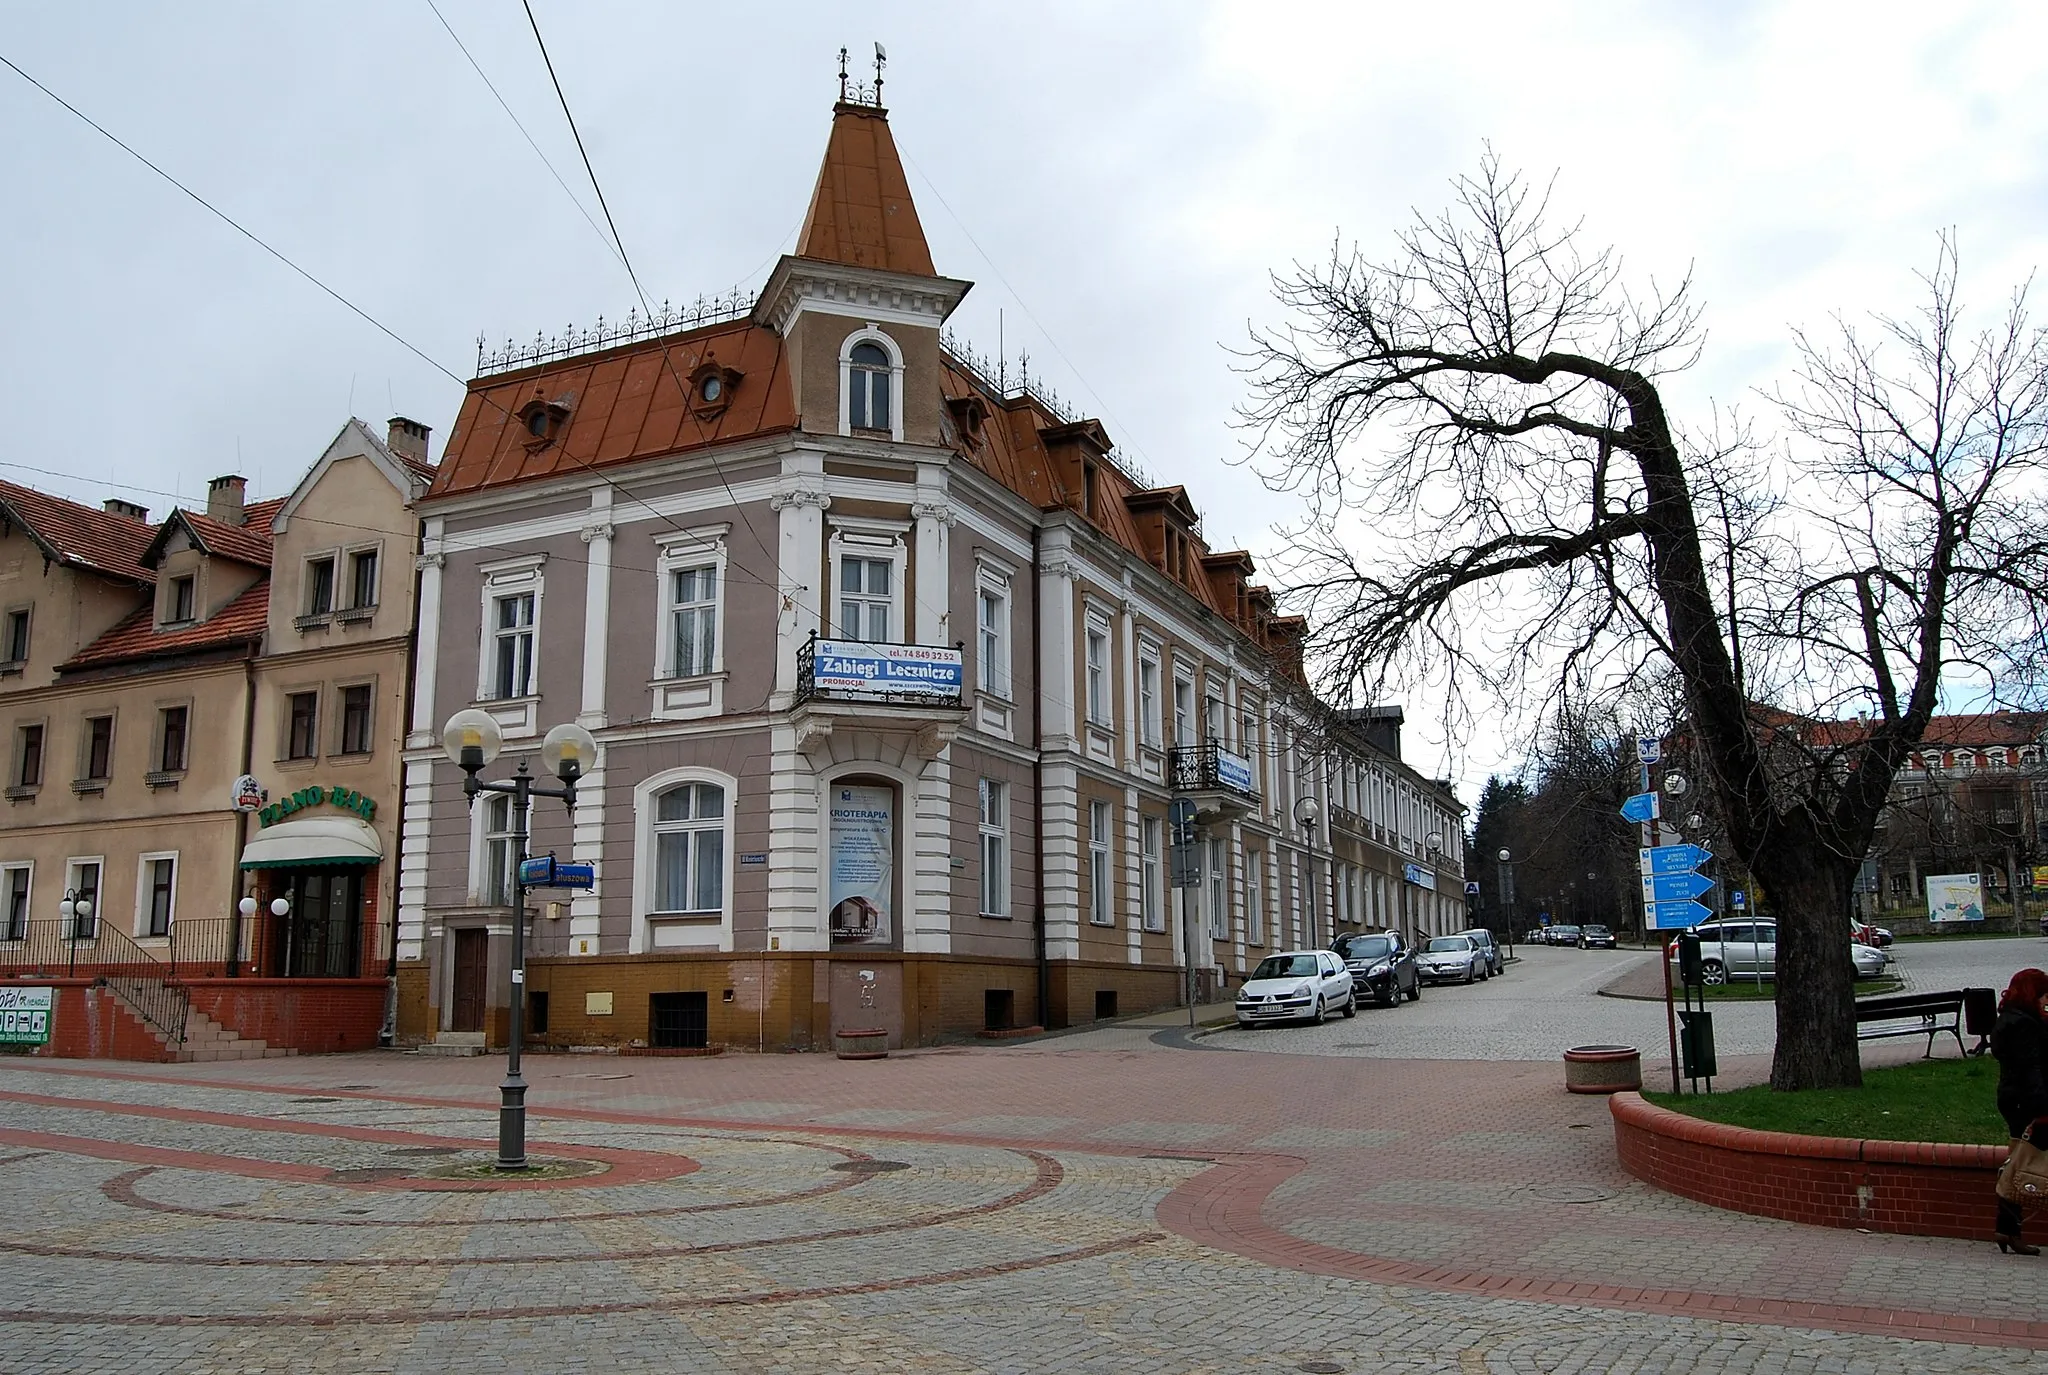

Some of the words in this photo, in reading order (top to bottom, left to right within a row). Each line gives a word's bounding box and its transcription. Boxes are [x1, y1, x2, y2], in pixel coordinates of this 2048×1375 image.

[915, 650, 930, 659] 849
[932, 652, 942, 660] 32
[822, 657, 879, 679] Zabiegi
[886, 661, 955, 681] Lecznicze
[822, 678, 866, 687] PROMOCJA!
[258, 785, 324, 829] PIANO
[331, 785, 378, 822] BAR
[1735, 892, 1742, 902] P
[0, 988, 21, 1008] otel
[7, 1015, 15, 1028] P
